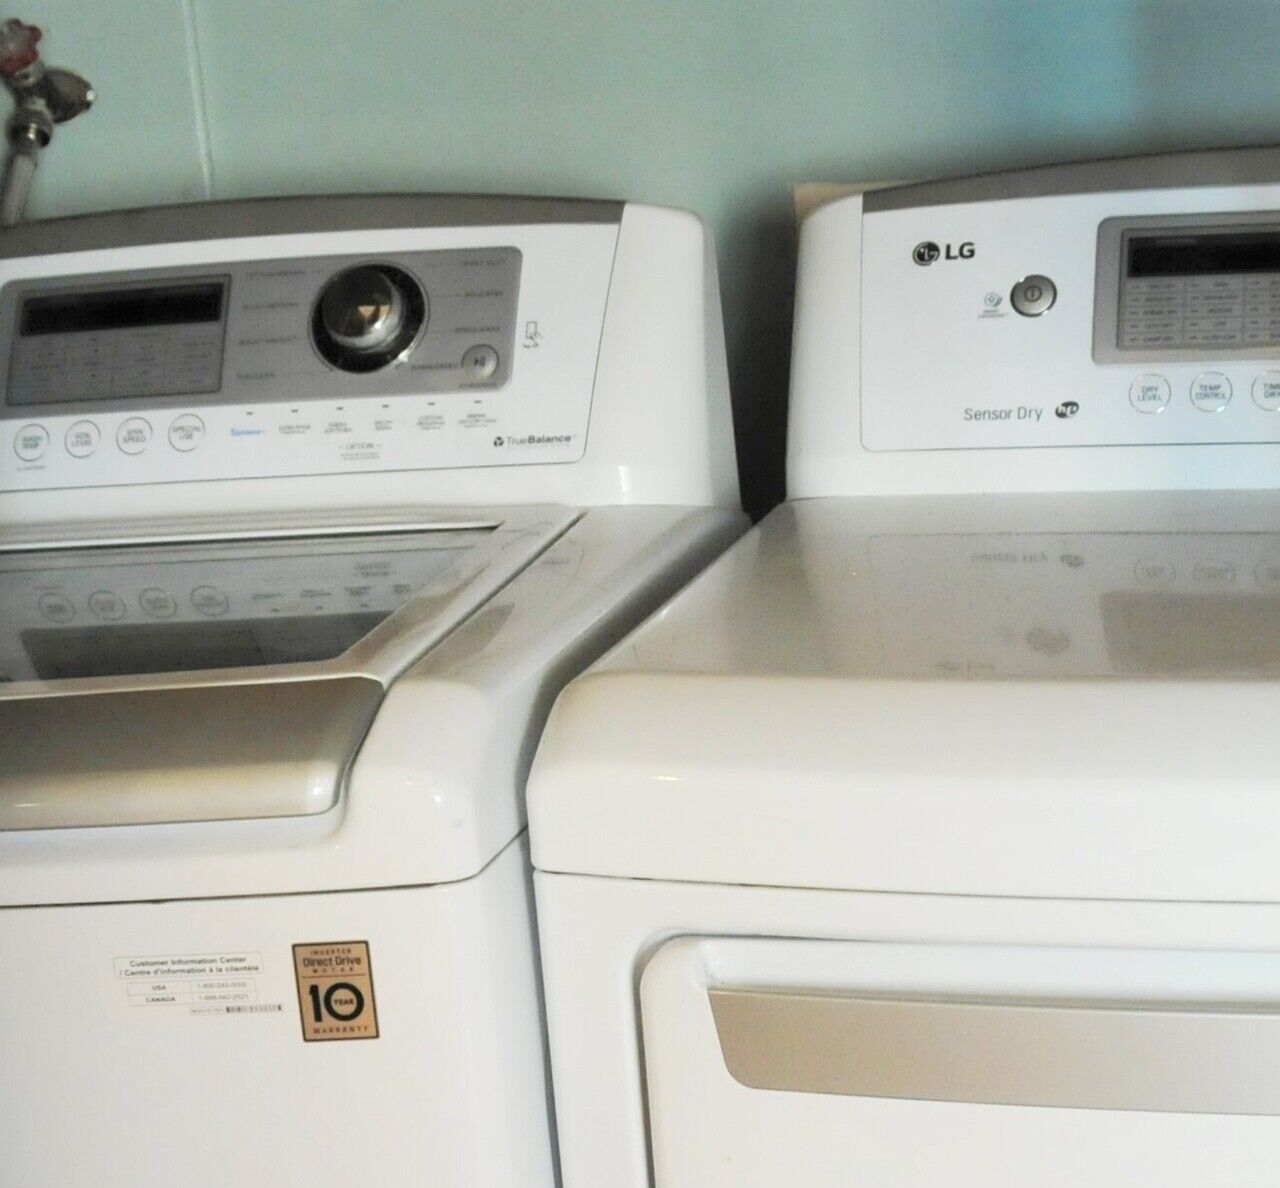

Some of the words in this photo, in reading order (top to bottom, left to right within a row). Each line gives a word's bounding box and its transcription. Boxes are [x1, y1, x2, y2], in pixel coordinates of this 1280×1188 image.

[944, 241, 976, 260] LG
[1141, 385, 1160, 393] DRY
[1199, 384, 1222, 392] TEMP
[1137, 392, 1162, 401] LEVEL
[963, 406, 1013, 421] Sensor
[1016, 405, 1043, 422] Dry
[506, 434, 573, 446] TrueBalance
[129, 959, 169, 968] Customer
[170, 957, 218, 966] Information
[219, 956, 247, 965] Center
[302, 957, 333, 967] Direct
[334, 955, 362, 966] Drive
[123, 968, 151, 977] Centre
[153, 967, 207, 976] d'information
[308, 982, 365, 1022] 10
[333, 998, 355, 1006] YEAR
[312, 1025, 369, 1035] WARRANTY
